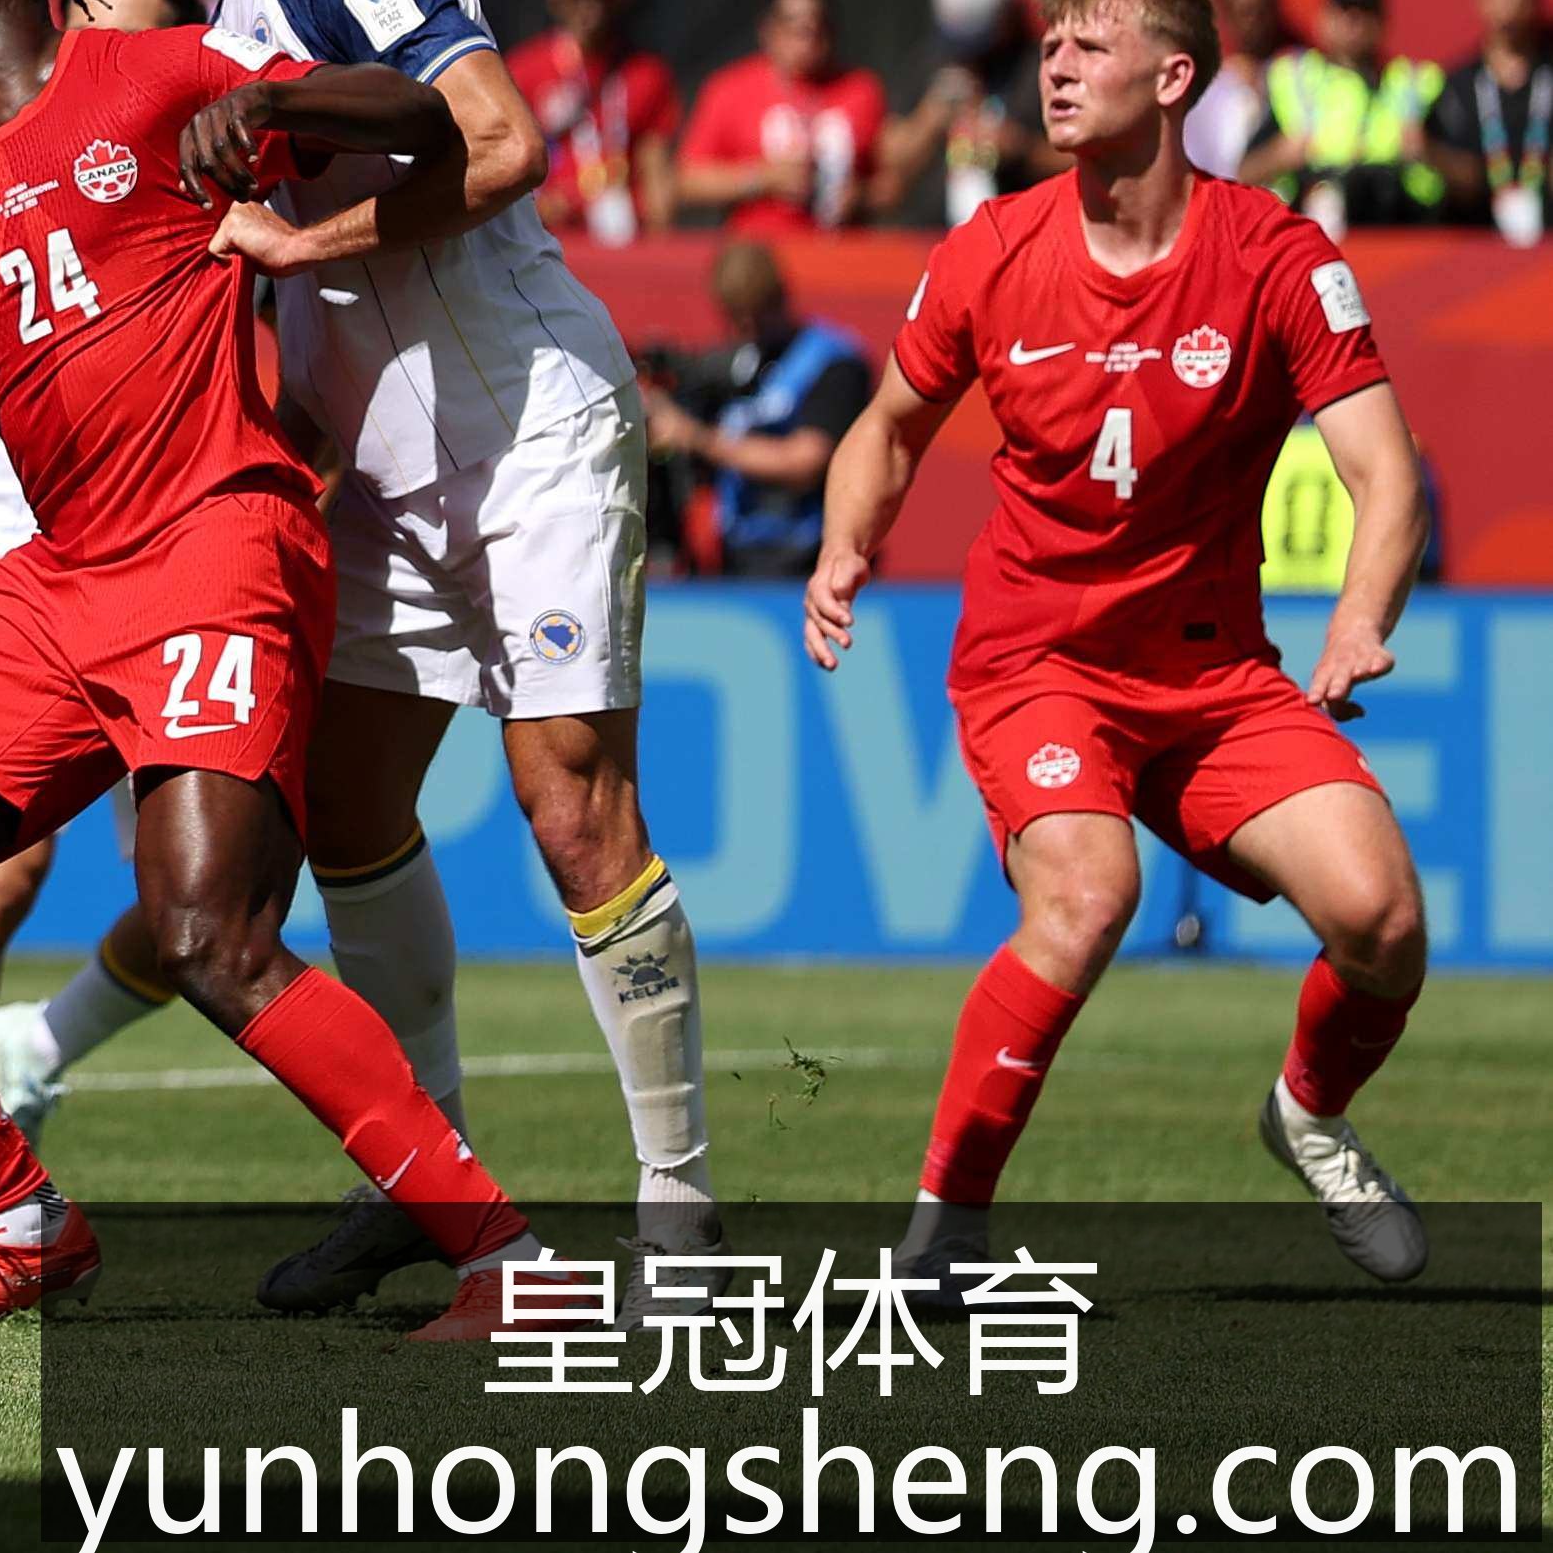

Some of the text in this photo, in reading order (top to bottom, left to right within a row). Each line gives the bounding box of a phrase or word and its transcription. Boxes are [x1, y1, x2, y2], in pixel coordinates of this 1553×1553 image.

[77, 161, 136, 184] CANADA
[1090, 408, 1138, 500] 4
[160, 633, 256, 726] 24
[619, 976, 680, 1004] KELME
